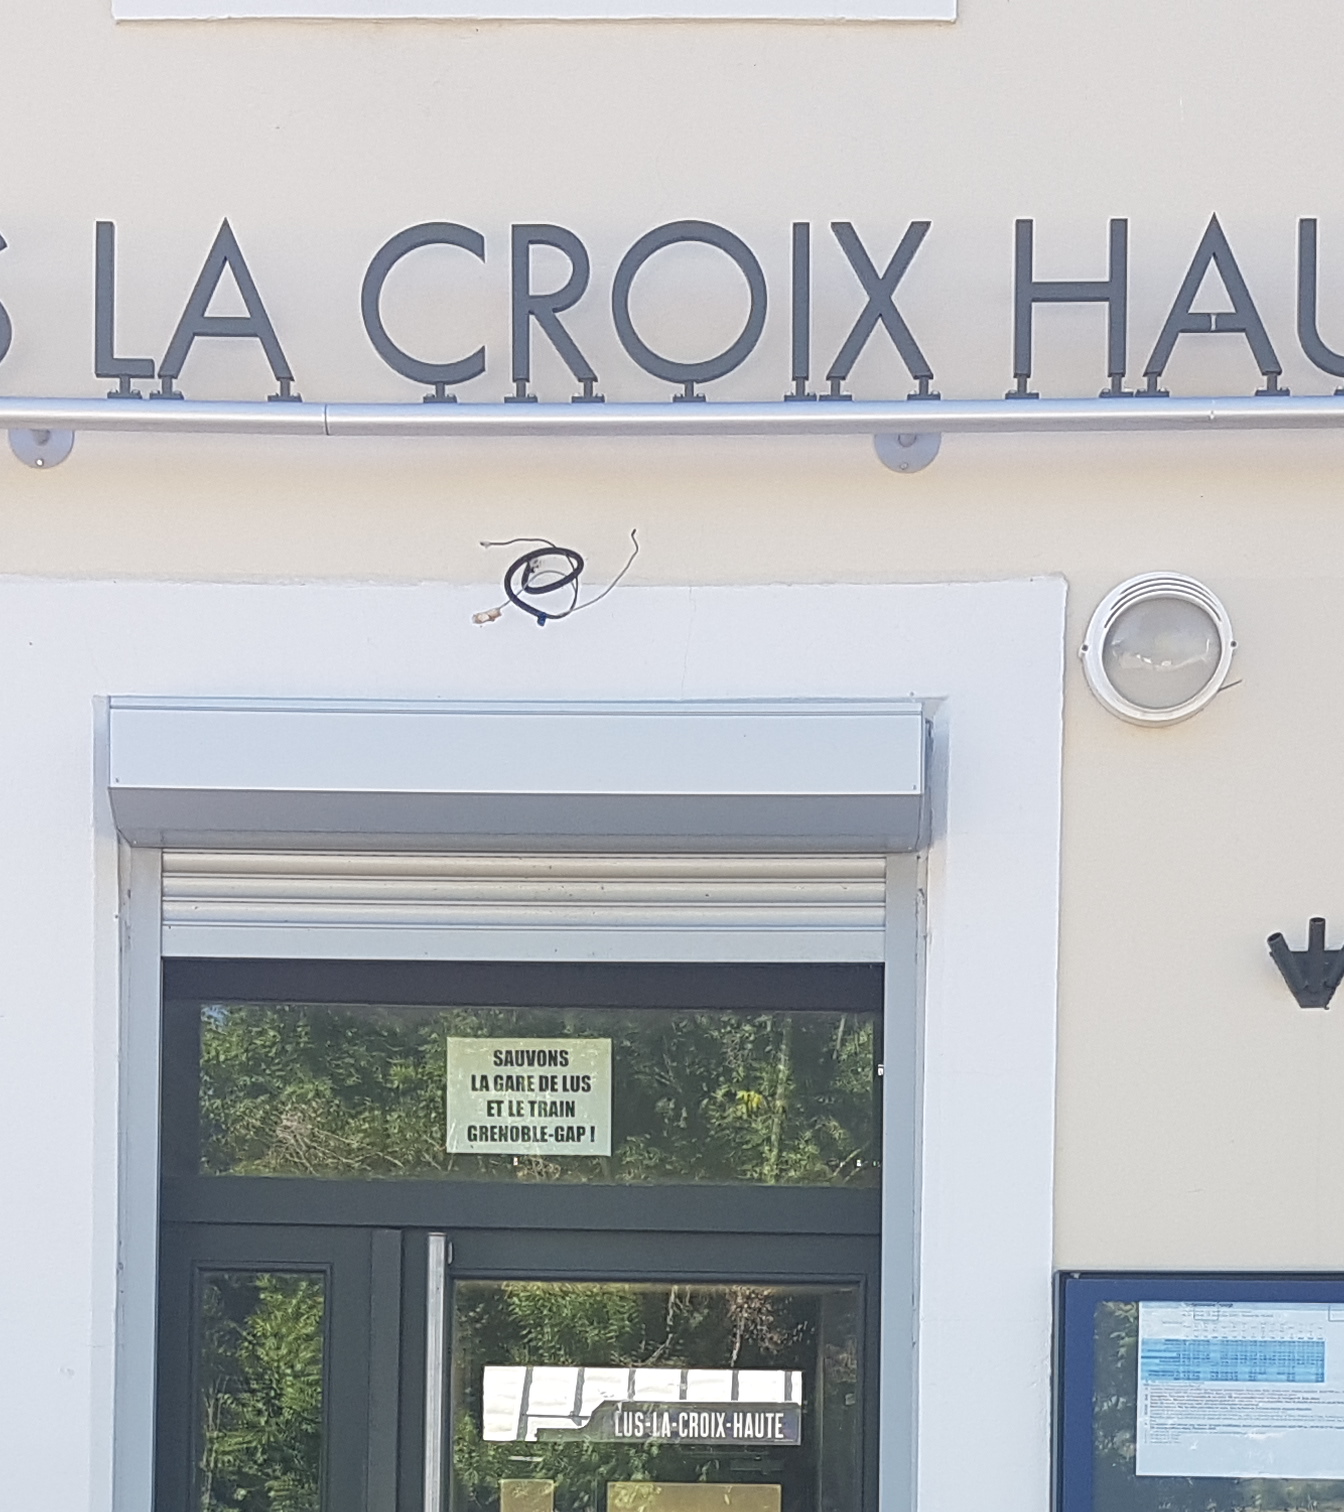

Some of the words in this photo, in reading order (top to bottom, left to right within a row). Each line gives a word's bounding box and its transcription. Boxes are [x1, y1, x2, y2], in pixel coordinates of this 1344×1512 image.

[94, 217, 295, 382] LA
[360, 219, 932, 385] CROIX
[492, 1050, 570, 1067] SAUVONS
[471, 1074, 490, 1092] LA
[493, 1074, 535, 1093] GARE
[538, 1075, 559, 1092] DE
[562, 1075, 592, 1093] LUS
[486, 1100, 505, 1118] ET
[508, 1100, 526, 1118] LE
[528, 1100, 576, 1118] TRAIN
[467, 1125, 587, 1143] GRENOBLE-GAP
[590, 1126, 596, 1143] !
[613, 1411, 784, 1438] LUS-LA-CROIX-HAUTE
